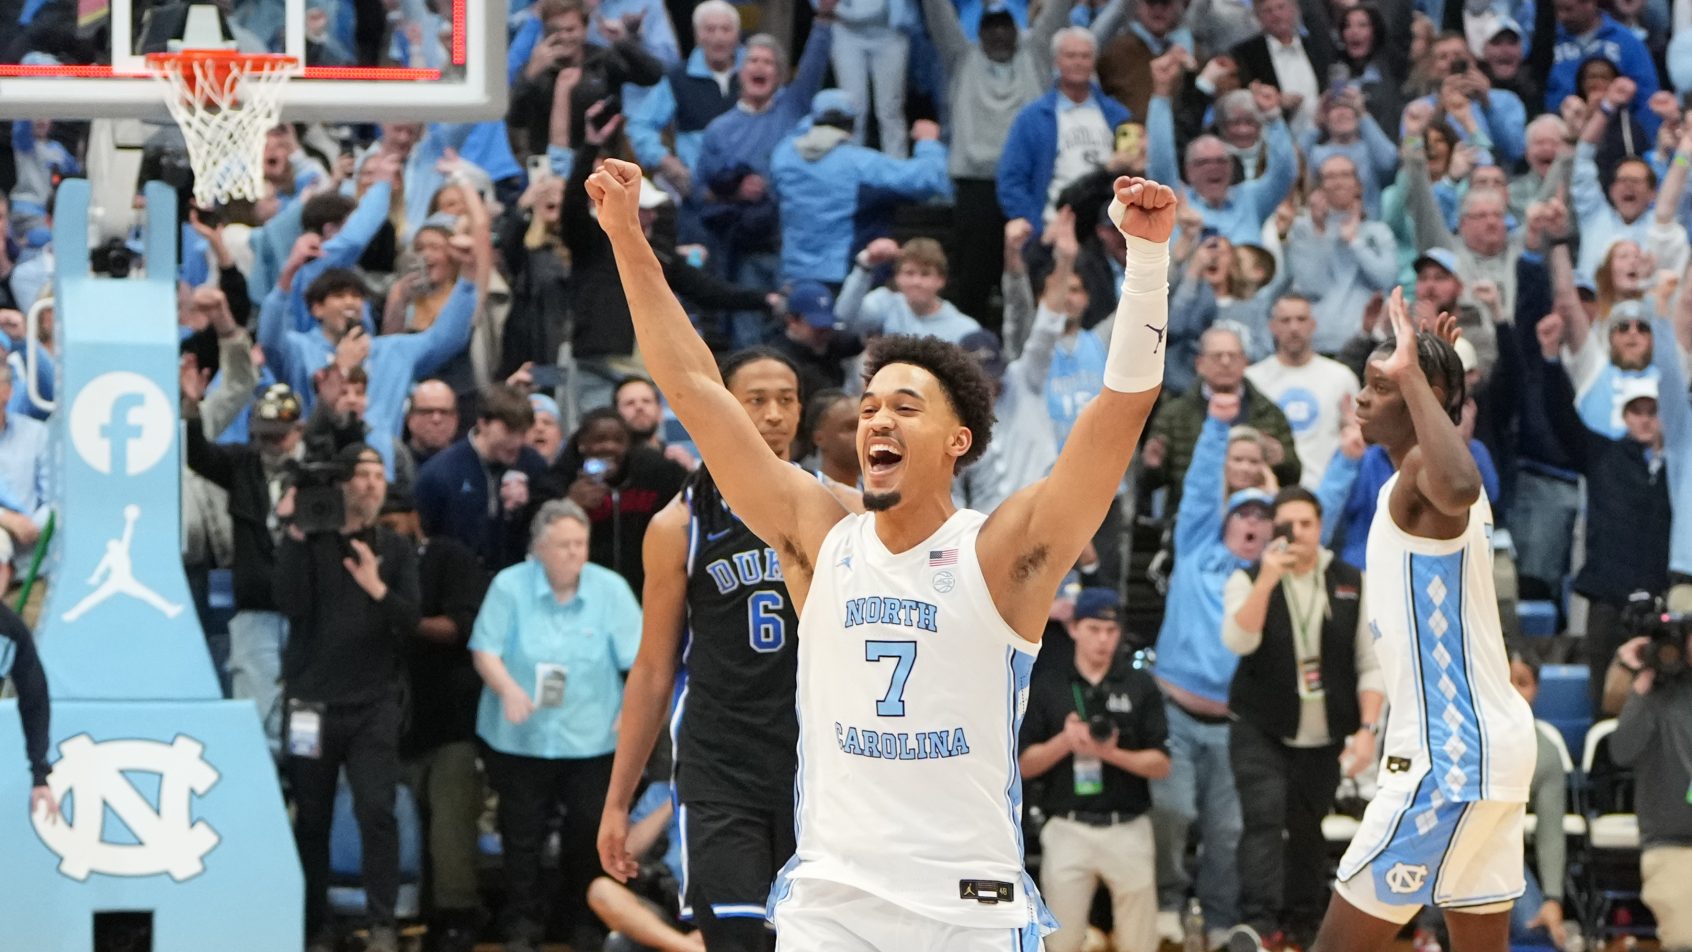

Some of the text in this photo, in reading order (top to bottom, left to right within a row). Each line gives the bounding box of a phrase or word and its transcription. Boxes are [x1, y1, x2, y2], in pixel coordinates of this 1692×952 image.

[706, 548, 785, 594] DUK
[748, 590, 786, 653] 6
[845, 596, 938, 632] NORTH
[865, 640, 917, 717] 7
[834, 721, 970, 760] CAROLINA
